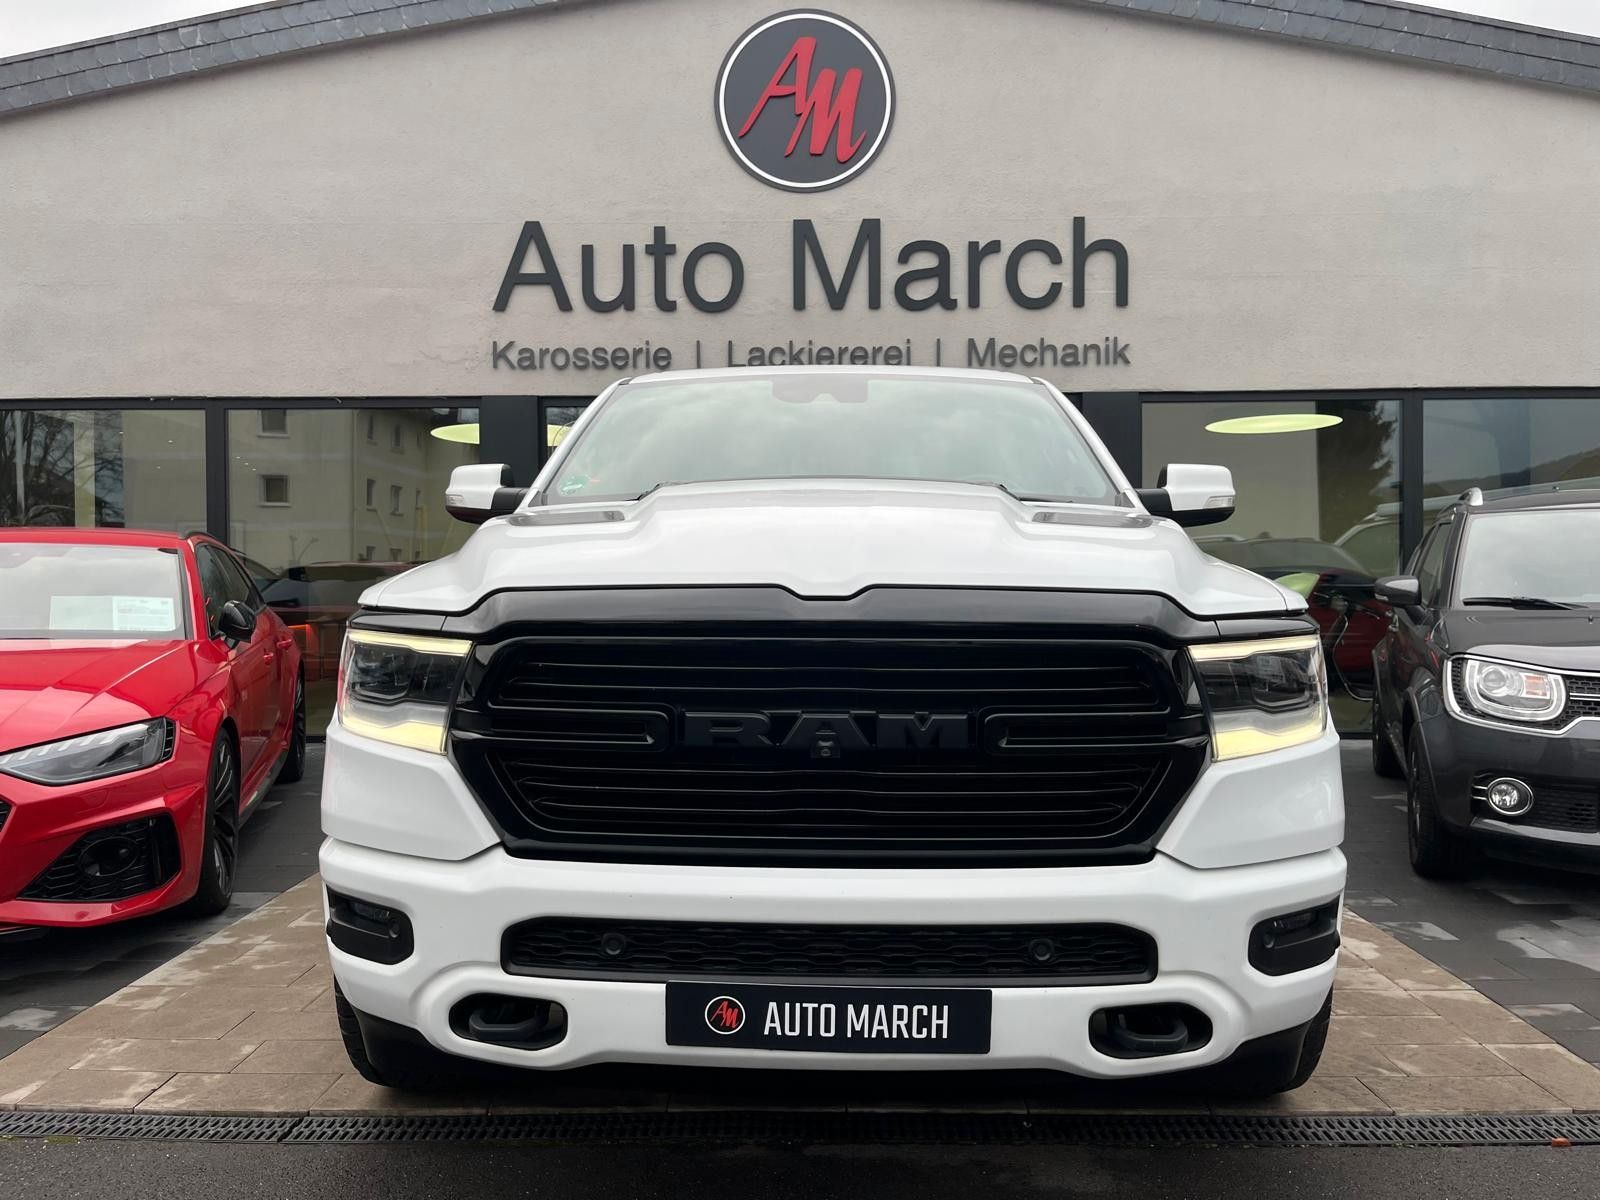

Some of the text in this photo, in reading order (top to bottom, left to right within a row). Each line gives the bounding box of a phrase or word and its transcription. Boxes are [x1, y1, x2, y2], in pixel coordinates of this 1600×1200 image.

[492, 216, 1129, 314] Auto March
[492, 340, 673, 371] Karosserie
[727, 339, 912, 367] Lackiererei
[967, 336, 1131, 368] Mechanik
[684, 711, 968, 748] RAM
[763, 1001, 836, 1038] AUTO
[846, 1003, 949, 1039] MARCH
